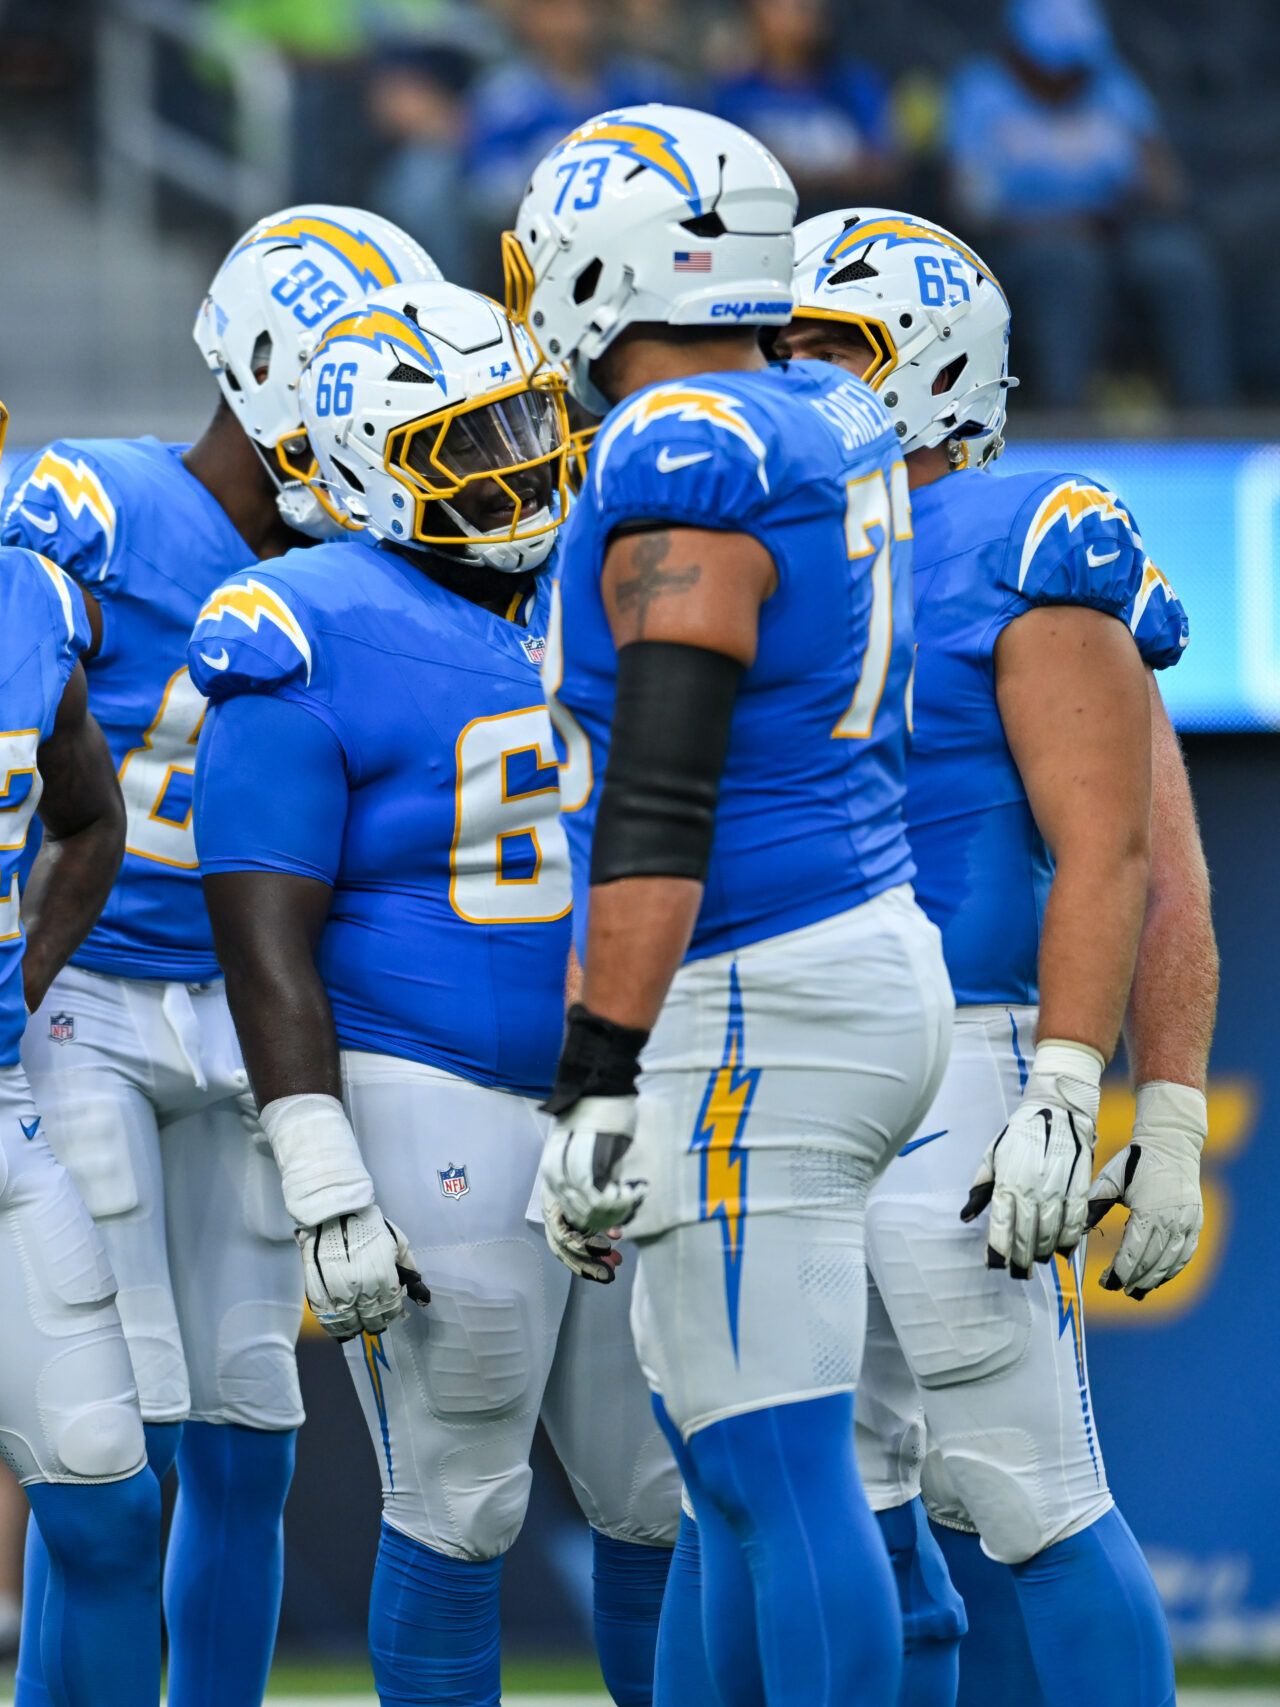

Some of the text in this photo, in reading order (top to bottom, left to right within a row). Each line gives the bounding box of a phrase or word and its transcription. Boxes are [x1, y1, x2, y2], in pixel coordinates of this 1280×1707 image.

[554, 157, 610, 216] 73
[271, 259, 348, 329] 89
[914, 255, 971, 308] 65
[316, 362, 359, 417] 66
[489, 361, 512, 382] LA
[444, 1178, 465, 1193] NFL
